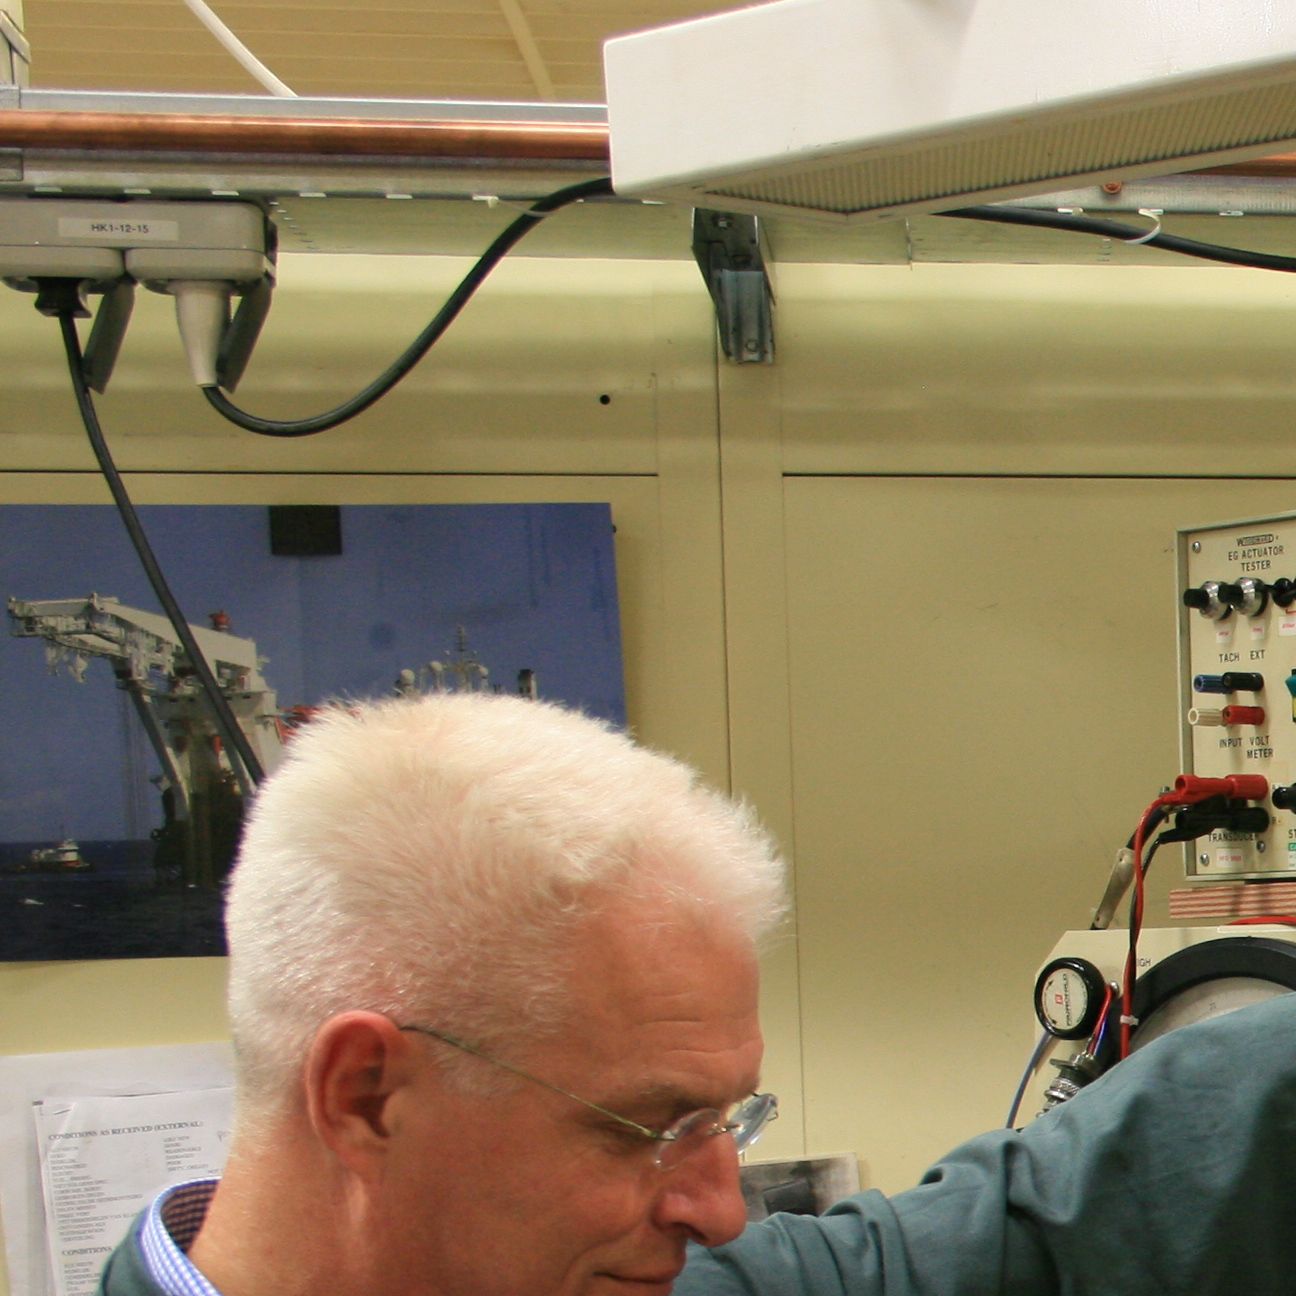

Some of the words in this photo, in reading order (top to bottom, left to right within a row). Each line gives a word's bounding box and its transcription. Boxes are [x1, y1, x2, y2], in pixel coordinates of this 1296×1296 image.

[1228, 551, 1239, 561] EG
[1242, 545, 1284, 559] ACTUATOR
[1241, 560, 1271, 572] TESTER
[1219, 653, 1240, 663] TACH
[1250, 649, 1265, 660] EXT
[1219, 737, 1242, 748] INPUT
[1250, 735, 1270, 747] VOLT
[1247, 748, 1273, 759] METER
